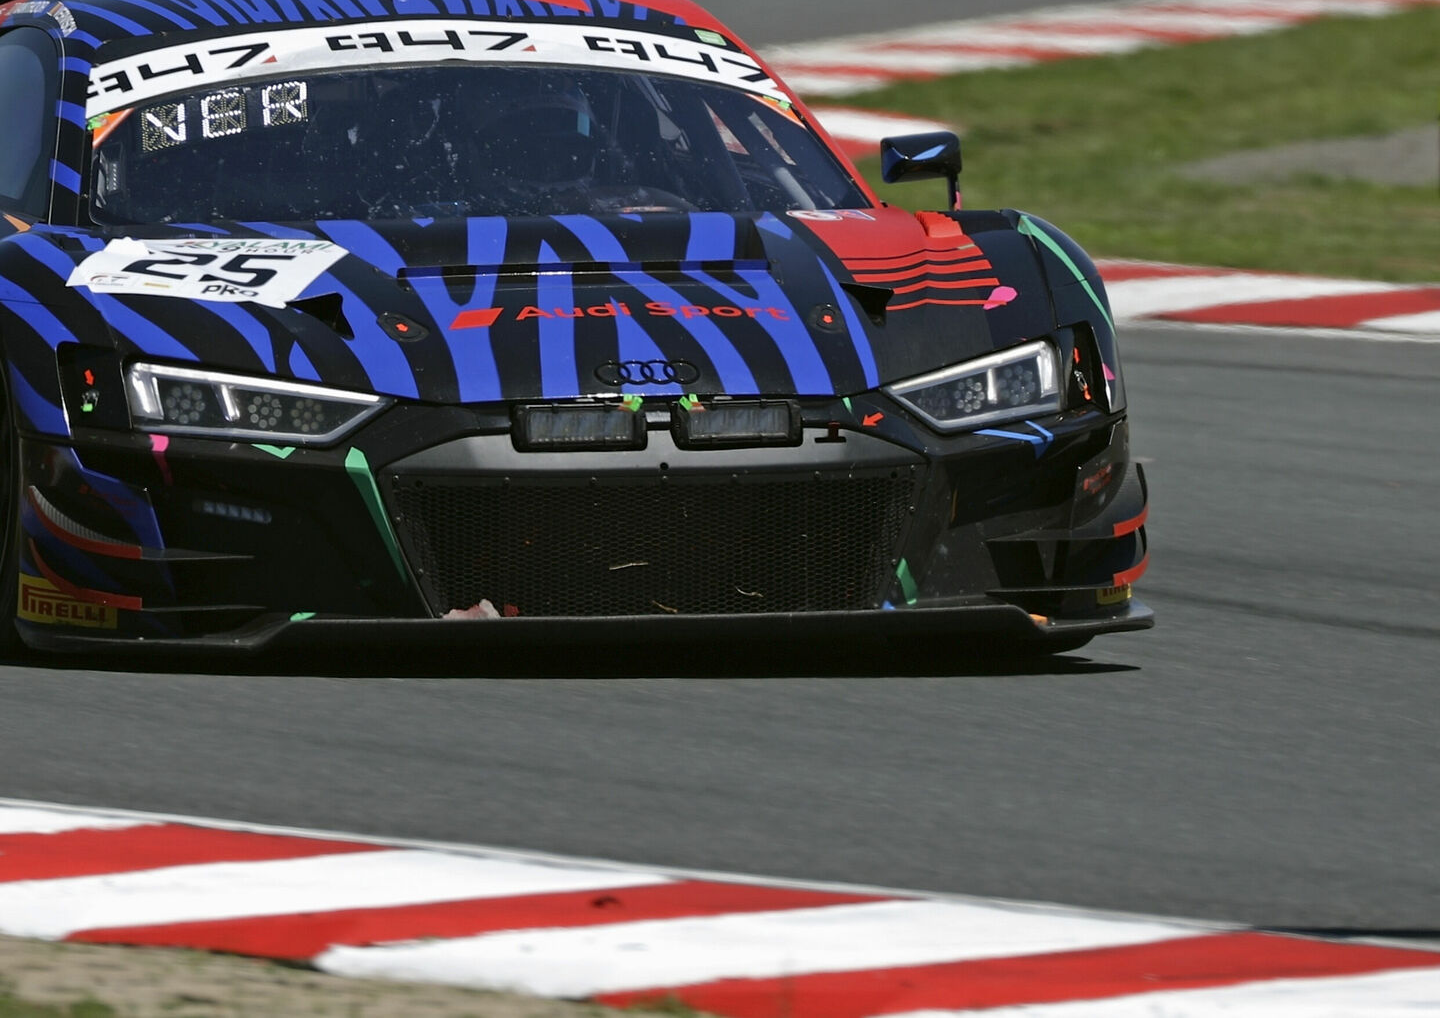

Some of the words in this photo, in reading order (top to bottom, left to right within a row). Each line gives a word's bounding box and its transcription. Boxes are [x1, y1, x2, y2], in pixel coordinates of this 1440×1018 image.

[326, 29, 531, 53] 947
[583, 35, 770, 83] 947
[87, 42, 270, 100] 947
[121, 251, 296, 288] 25
[245, 247, 314, 255] HOUR
[515, 303, 636, 322] Audi
[642, 300, 791, 322] Sport
[22, 583, 106, 623] PIRELLI
